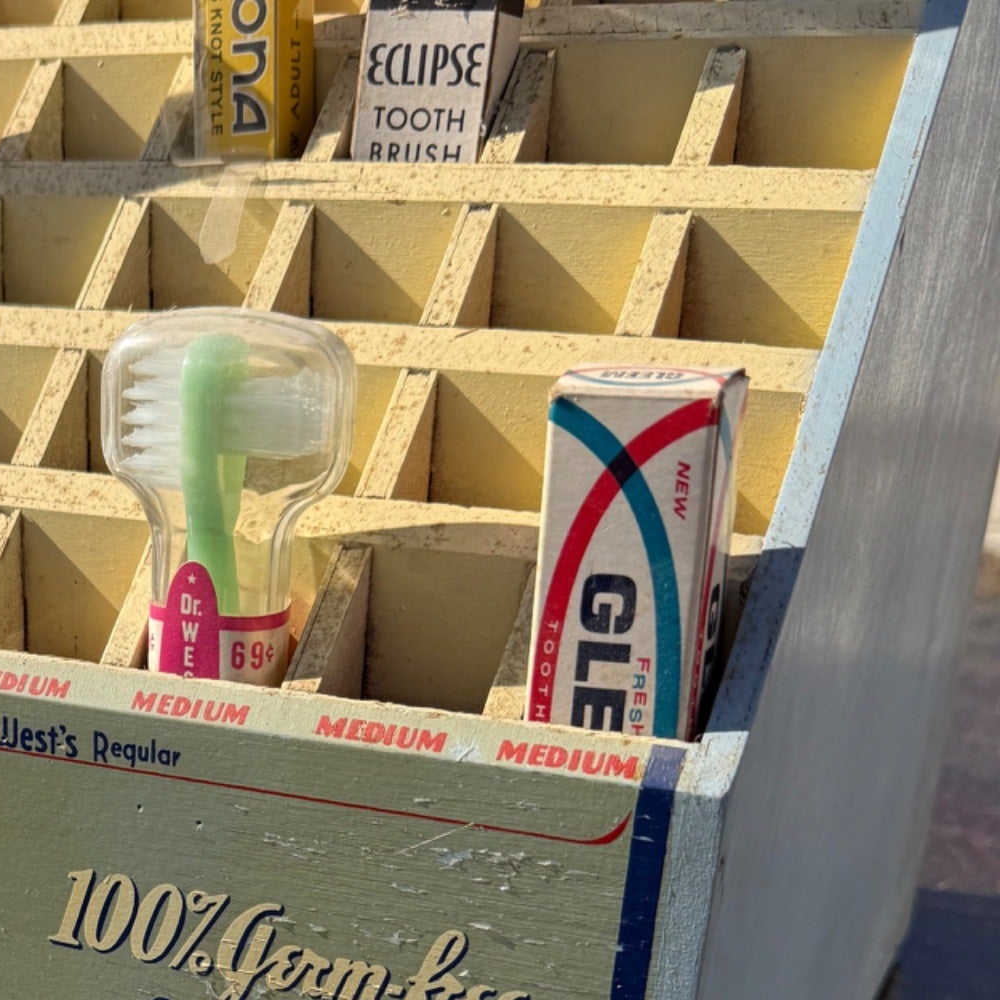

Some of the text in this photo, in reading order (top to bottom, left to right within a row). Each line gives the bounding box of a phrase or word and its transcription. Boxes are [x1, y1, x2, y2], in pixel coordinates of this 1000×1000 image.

[210, 9, 223, 137] KNOT STYLE
[290, 37, 300, 121] ADULT
[367, 43, 485, 87] ECLIPSE
[374, 106, 465, 133] TOOTH
[369, 142, 461, 163] BRUSH
[673, 461, 691, 520] NEW
[180, 593, 202, 616] Dr.
[231, 640, 274, 670] 69¢
[535, 620, 559, 718] TOOTH
[131, 691, 250, 726] MEDIUM
[94, 731, 182, 768] Regular
[315, 715, 447, 753] MEDIUM
[495, 739, 640, 780] MEDIUM
[48, 869, 231, 976] 100%
